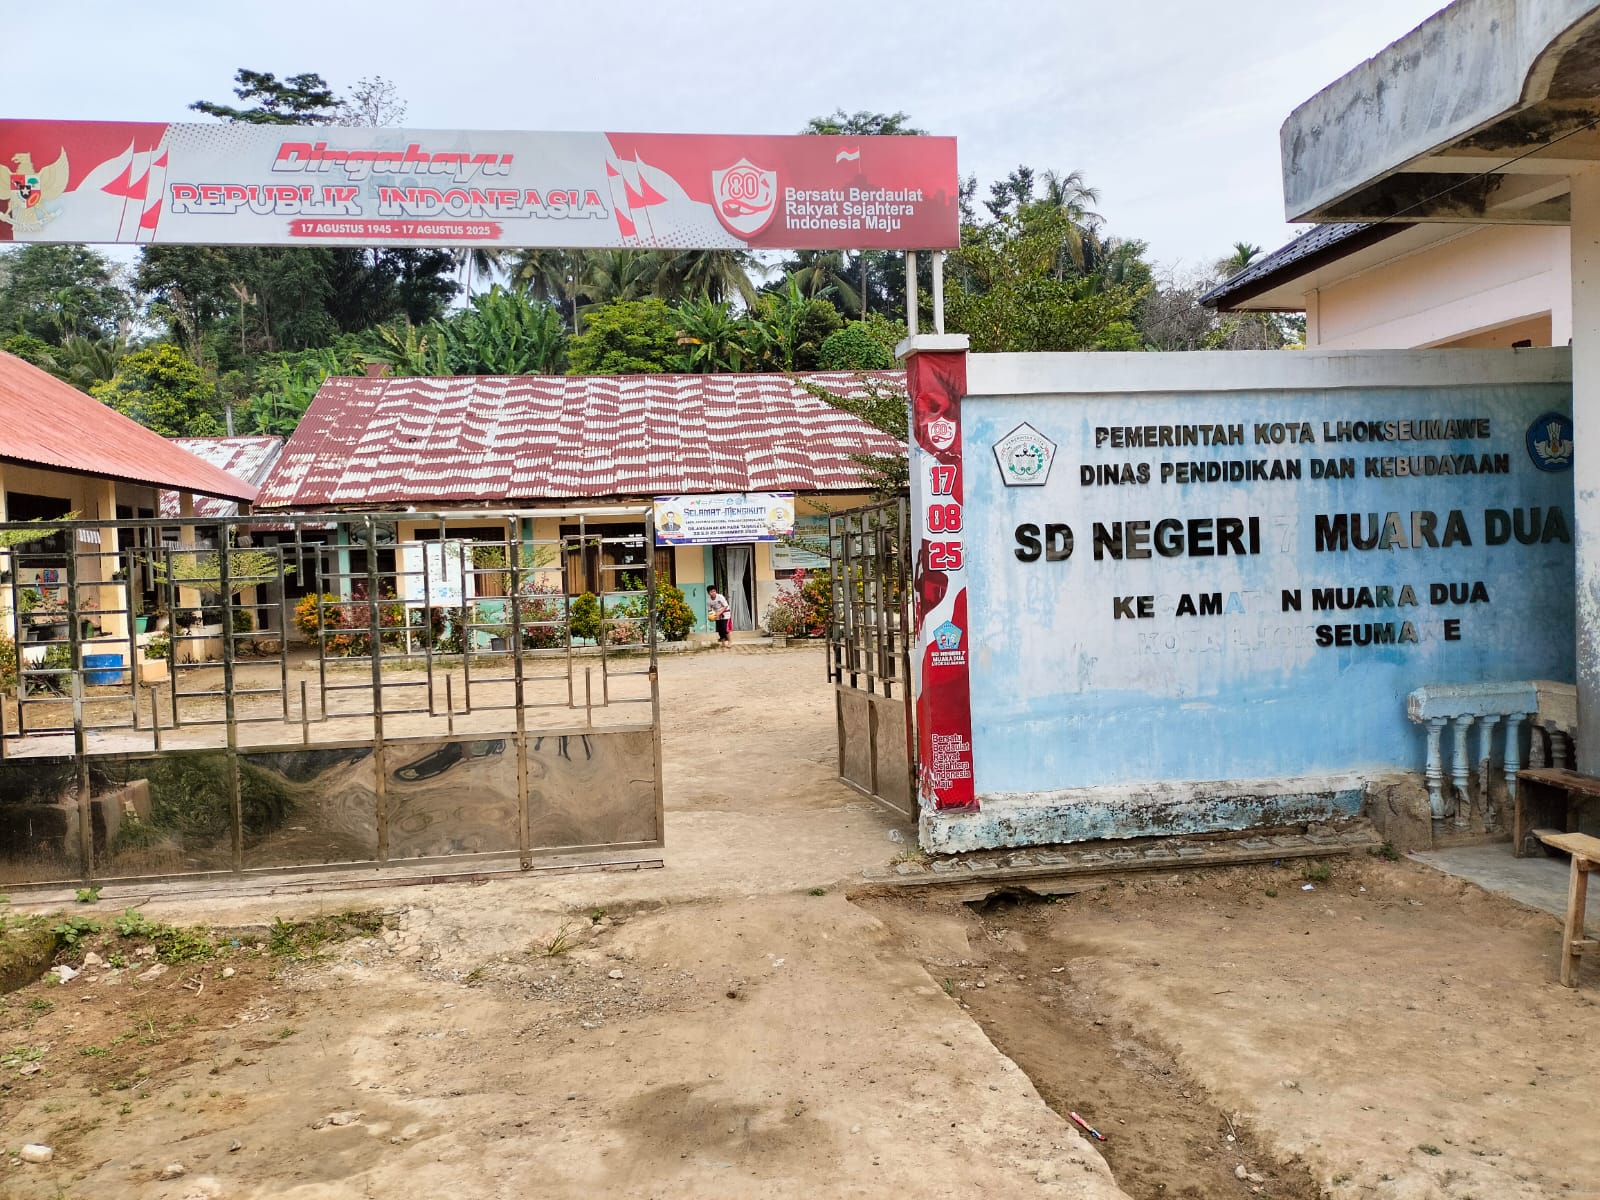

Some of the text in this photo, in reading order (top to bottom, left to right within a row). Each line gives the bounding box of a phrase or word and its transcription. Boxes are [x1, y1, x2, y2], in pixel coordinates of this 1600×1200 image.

[272, 142, 514, 183] Dirgahayu
[727, 171, 760, 199] 80
[171, 183, 609, 219] REPUBLIK INDONEASIA
[785, 187, 923, 202] Bersatu Berdaulat
[786, 202, 914, 219] Rakyat Sejahtera
[301, 224, 313, 233] 17
[316, 224, 364, 233] AGUSTUS
[367, 224, 392, 234] 1945
[402, 224, 413, 234] 17
[416, 225, 464, 235] AGUSTUS
[466, 225, 490, 235] 2025
[786, 216, 901, 232] Indonesia Maju
[1095, 418, 1491, 448] PEMERINTAH KOTA LHOKSEUMAWE
[1080, 454, 1509, 486] DINAS PENDIDIKAN DAN KEBUDAYAAN
[930, 464, 957, 495] 17
[683, 506, 766, 517] SELAMAT MENGIKUTI
[927, 503, 963, 533] 08
[1014, 522, 1074, 563] SD
[1092, 516, 1260, 561] NEGERI
[1314, 510, 1473, 552] MUARA
[1485, 506, 1571, 546] DUA
[929, 541, 964, 571] 25
[1312, 584, 1419, 611] MUARA
[1429, 581, 1490, 605] DUA
[931, 733, 963, 743] Bersatu
[932, 741, 970, 752] Berdaulat
[933, 751, 960, 762] Rakyat
[933, 760, 970, 770] Sejahtera
[933, 769, 971, 780] Indonesia
[934, 780, 953, 790] Maju
